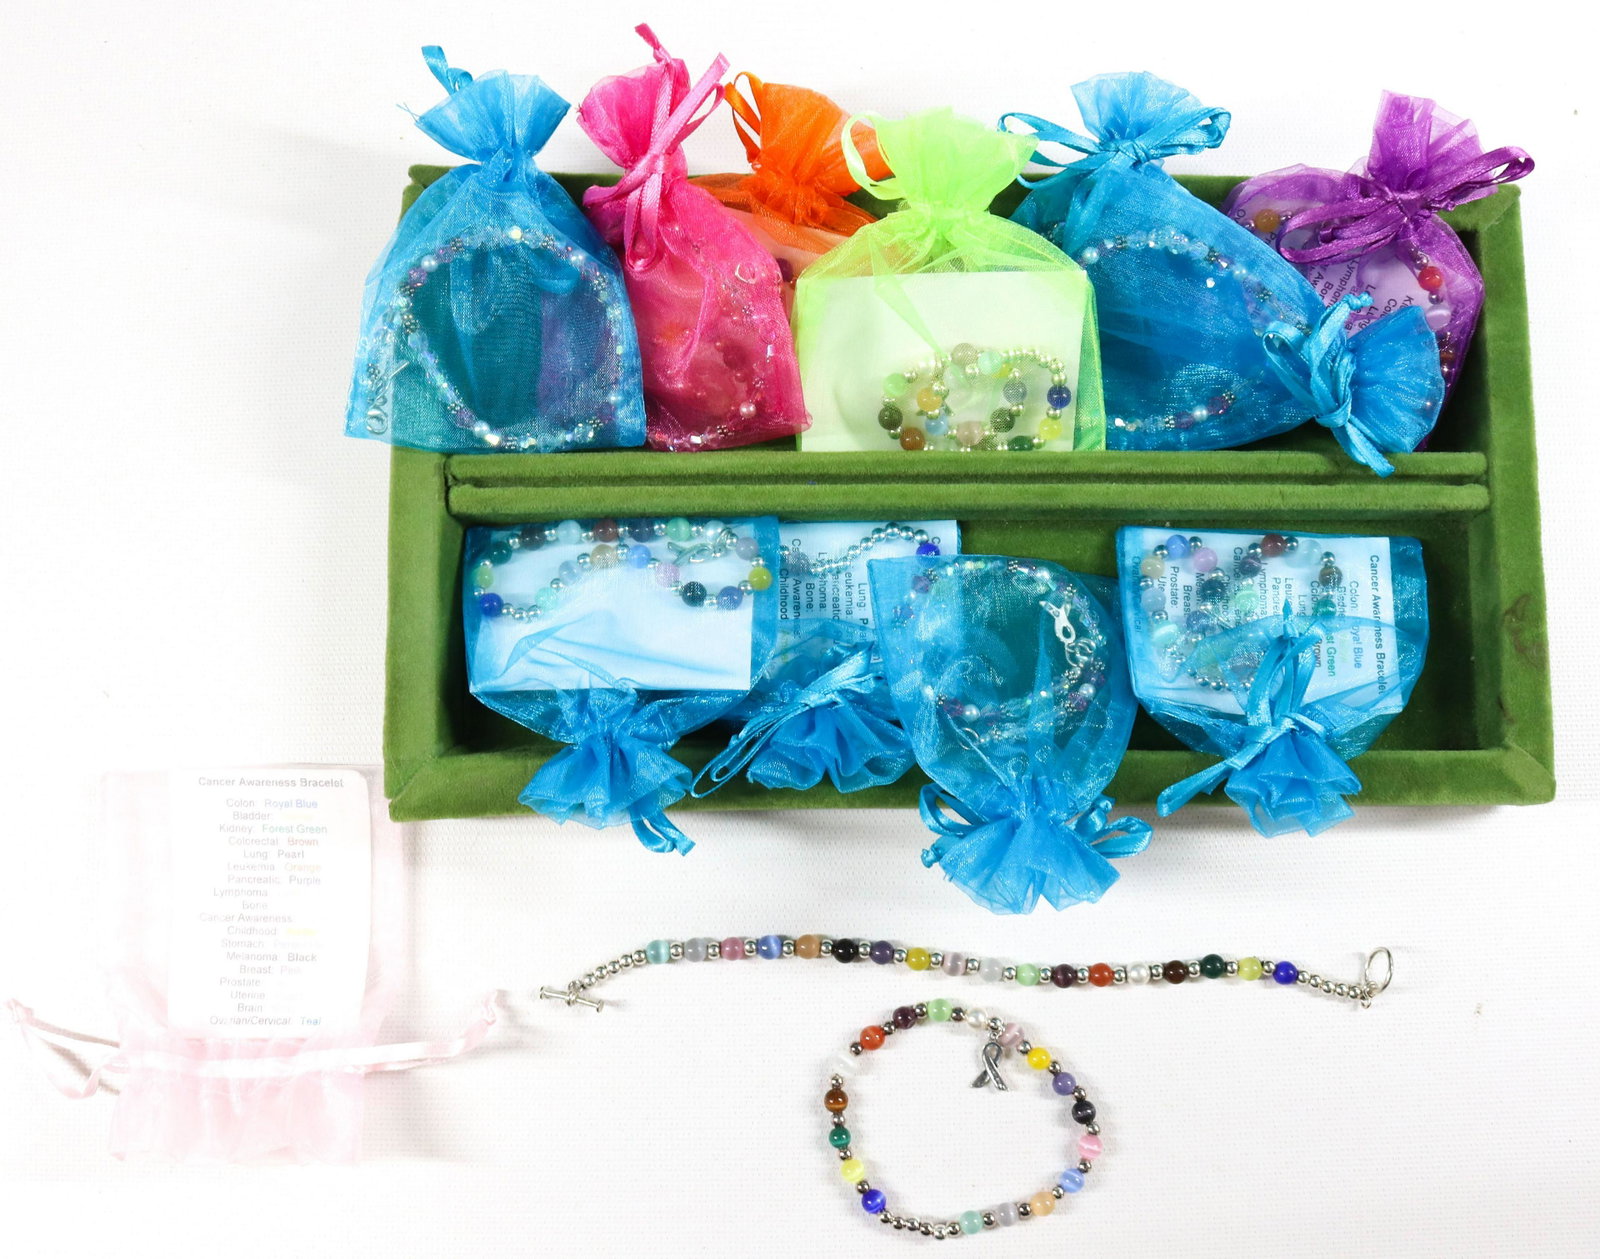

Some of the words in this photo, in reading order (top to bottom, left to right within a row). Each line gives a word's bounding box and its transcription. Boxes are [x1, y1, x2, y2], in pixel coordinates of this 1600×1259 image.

[1370, 554, 1381, 591] Cancer
[1353, 647, 1364, 669] Blue
[198, 776, 236, 787] Cancer
[238, 777, 297, 788] Awareness
[299, 777, 345, 788] Bracelet
[264, 799, 293, 810] Royal
[295, 799, 319, 808] Blue
[261, 823, 294, 834] Forest
[296, 823, 328, 834] Green
[287, 837, 319, 846] Brown
[277, 849, 305, 859] Pearl
[288, 875, 321, 886] Purple
[287, 952, 318, 963] Black
